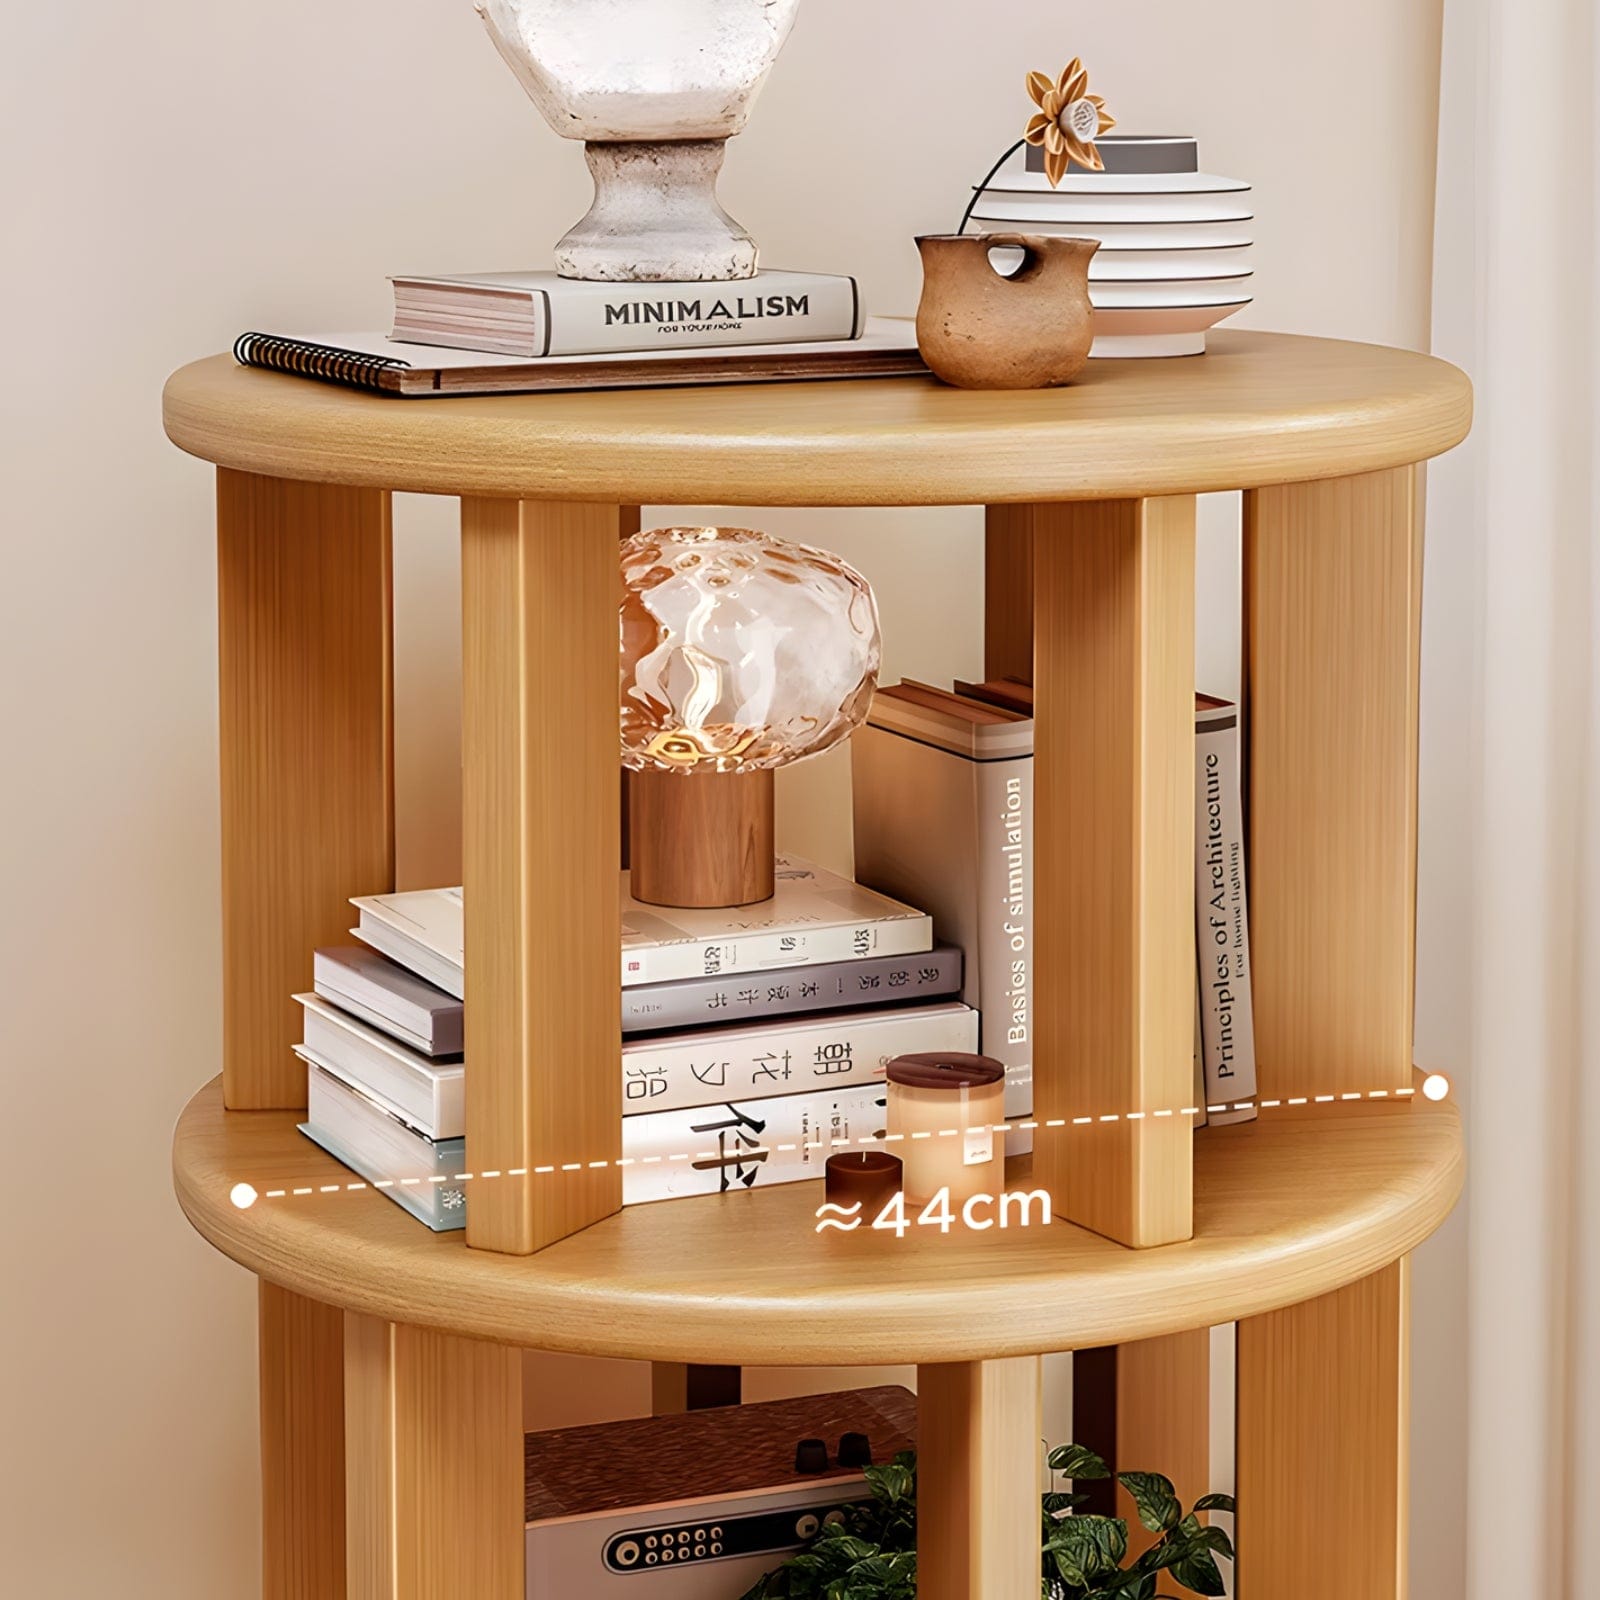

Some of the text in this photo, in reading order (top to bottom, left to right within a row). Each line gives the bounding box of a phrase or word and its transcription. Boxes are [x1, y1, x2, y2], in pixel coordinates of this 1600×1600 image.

[604, 294, 810, 325] MINIMALISM
[1001, 777, 1024, 915] simulation
[1004, 922, 1025, 952] of
[1205, 752, 1235, 1079] Principles of Architecture
[1006, 958, 1027, 1044] Basics
